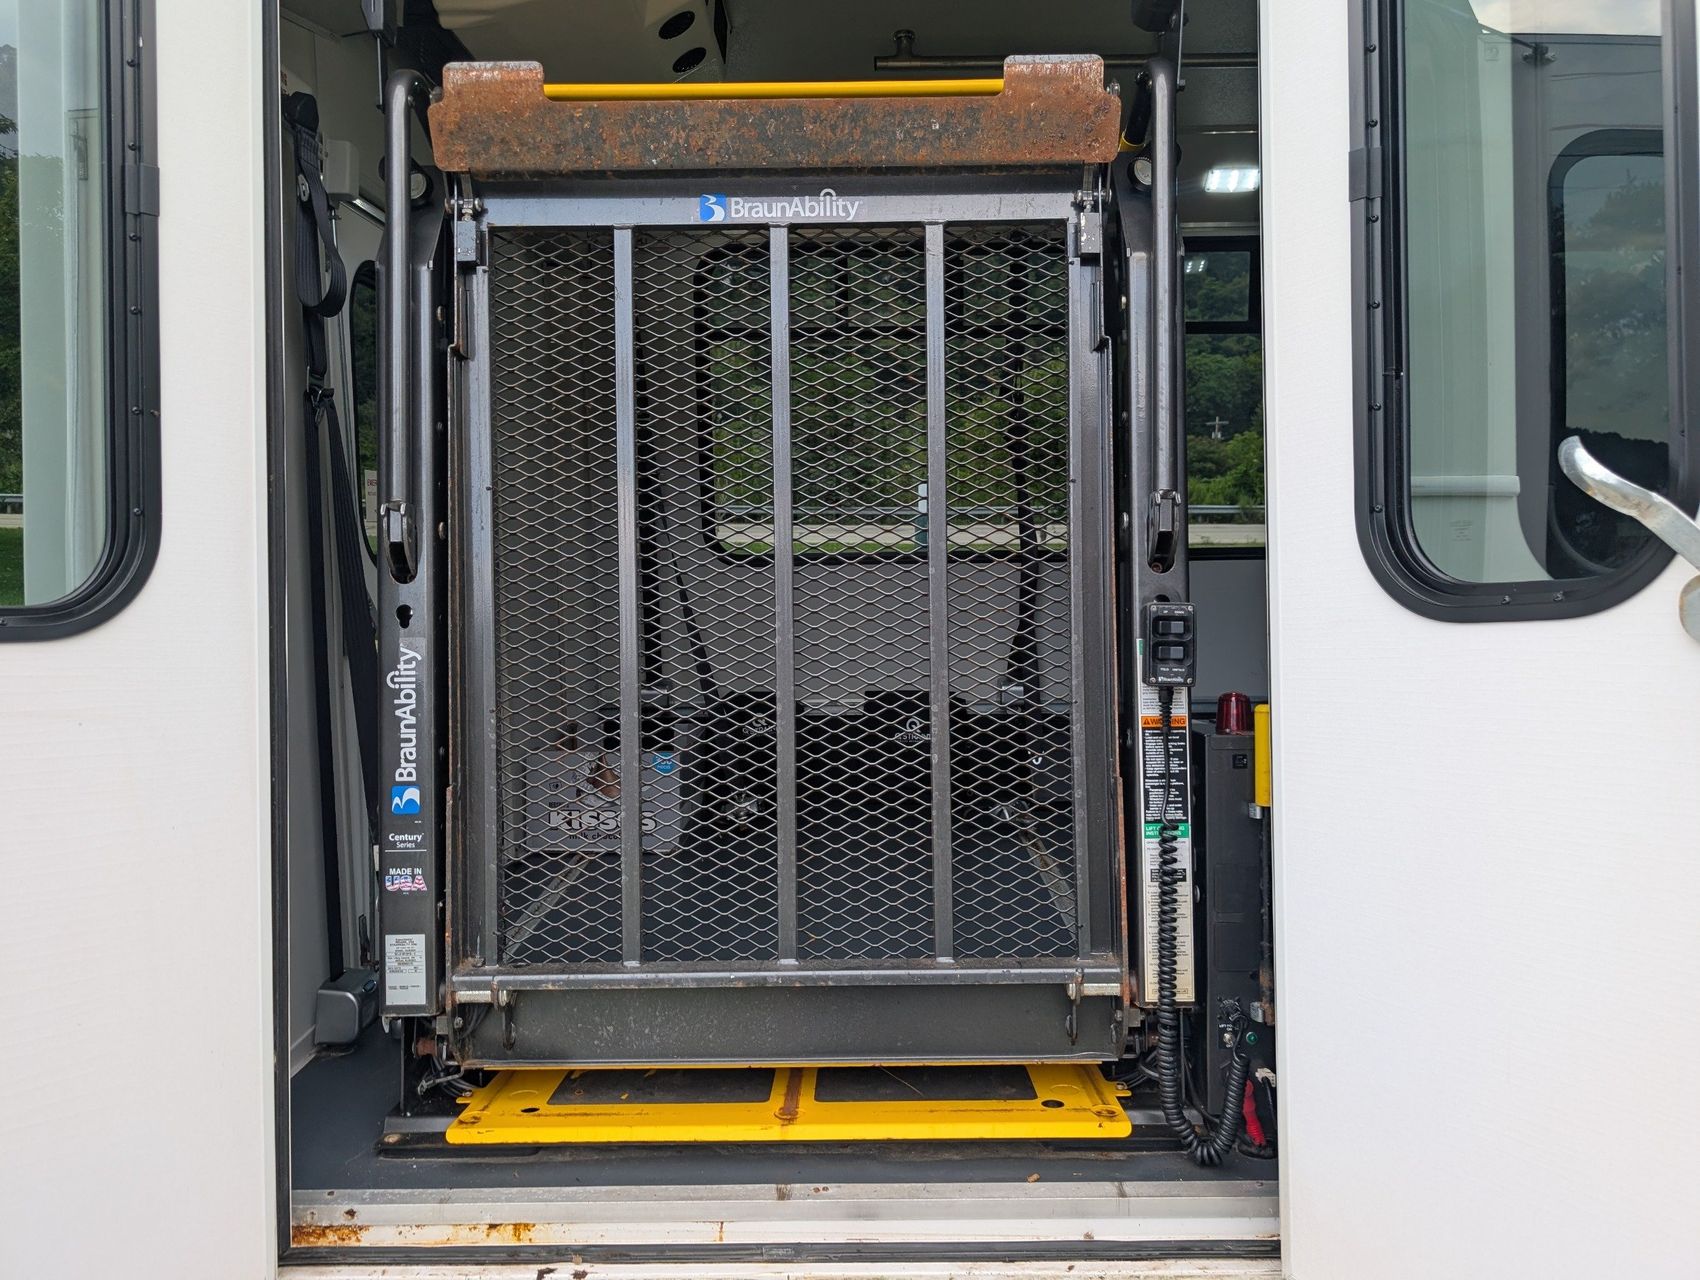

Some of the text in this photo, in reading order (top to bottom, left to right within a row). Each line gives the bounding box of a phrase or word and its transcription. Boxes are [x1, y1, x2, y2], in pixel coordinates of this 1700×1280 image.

[730, 188, 860, 221] BraunAbility
[386, 646, 422, 782] BraunAbility
[548, 810, 658, 832] KISSS
[388, 833, 422, 843] Century
[389, 867, 422, 875] MADE IN
[384, 875, 428, 892] USA
